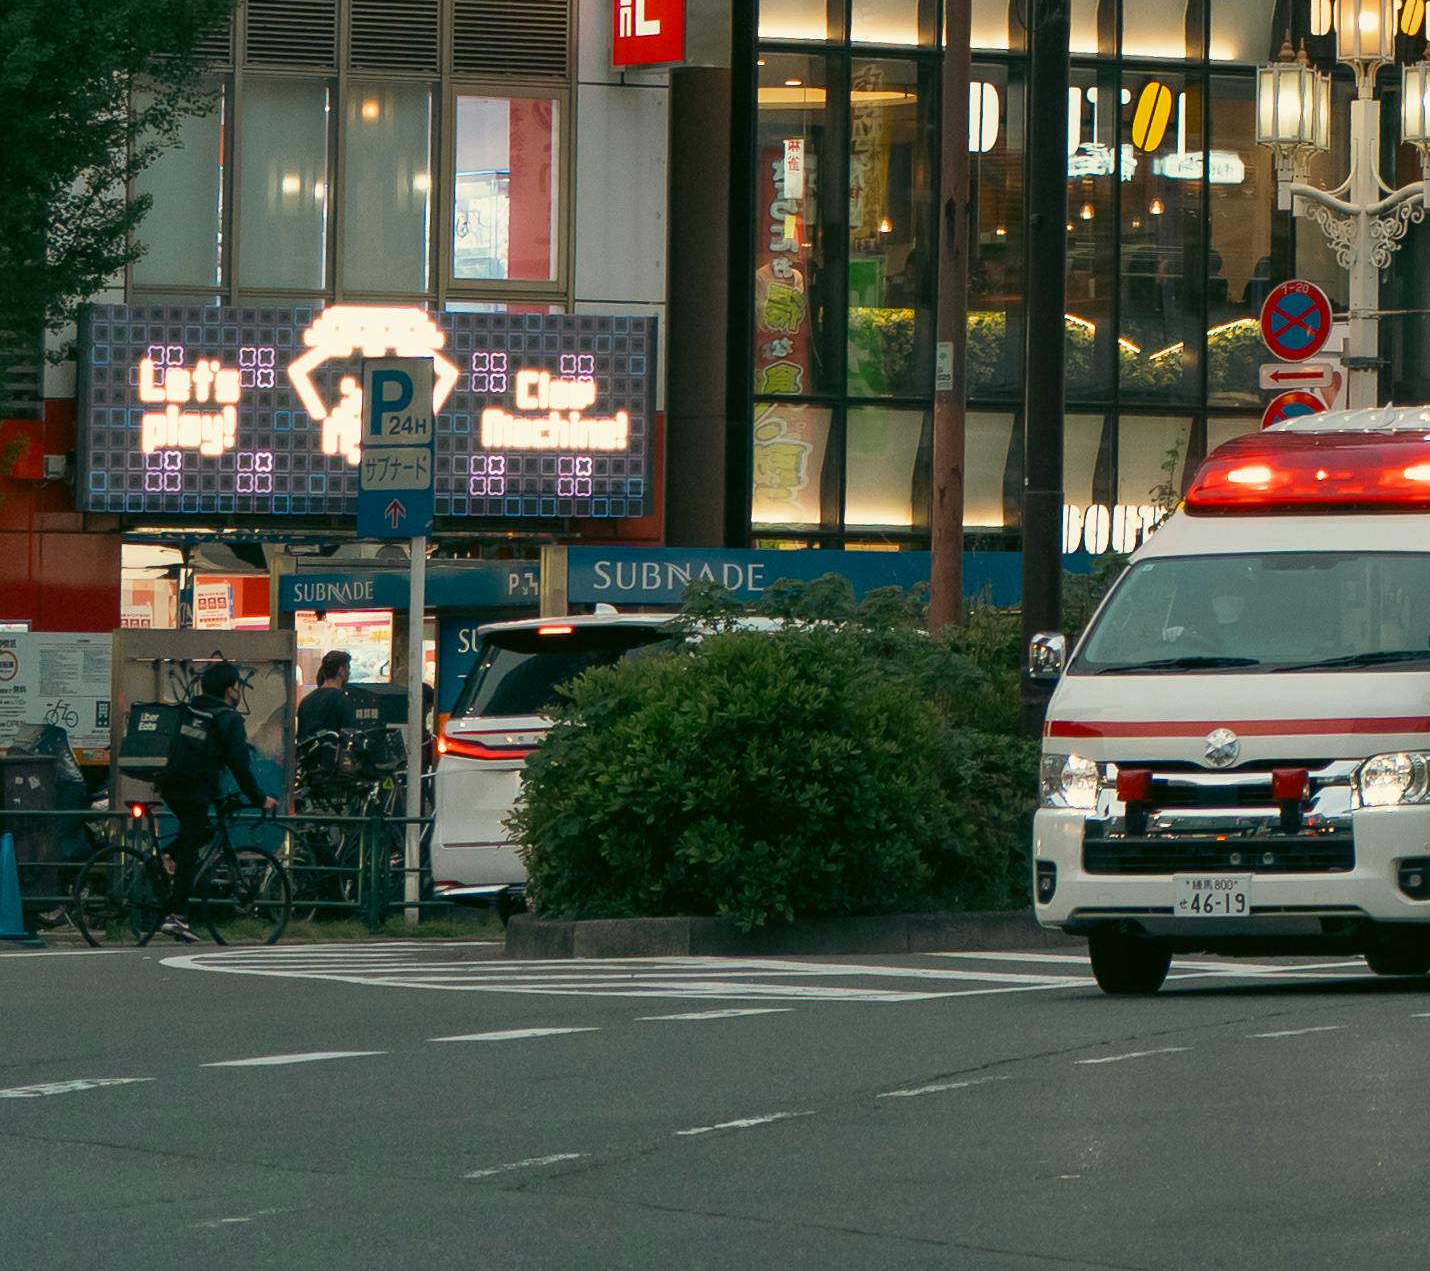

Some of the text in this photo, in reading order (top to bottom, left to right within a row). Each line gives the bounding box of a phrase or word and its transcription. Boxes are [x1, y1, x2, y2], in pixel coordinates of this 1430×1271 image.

[138, 358, 241, 404] Let's
[370, 368, 415, 437] P
[142, 407, 237, 455] play!
[388, 414, 428, 437] 24H
[366, 456, 429, 486] サブナード
[293, 580, 374, 602] SUBNADE
[592, 560, 767, 592] SUBNADE
[1190, 891, 1247, 917] 46-19
